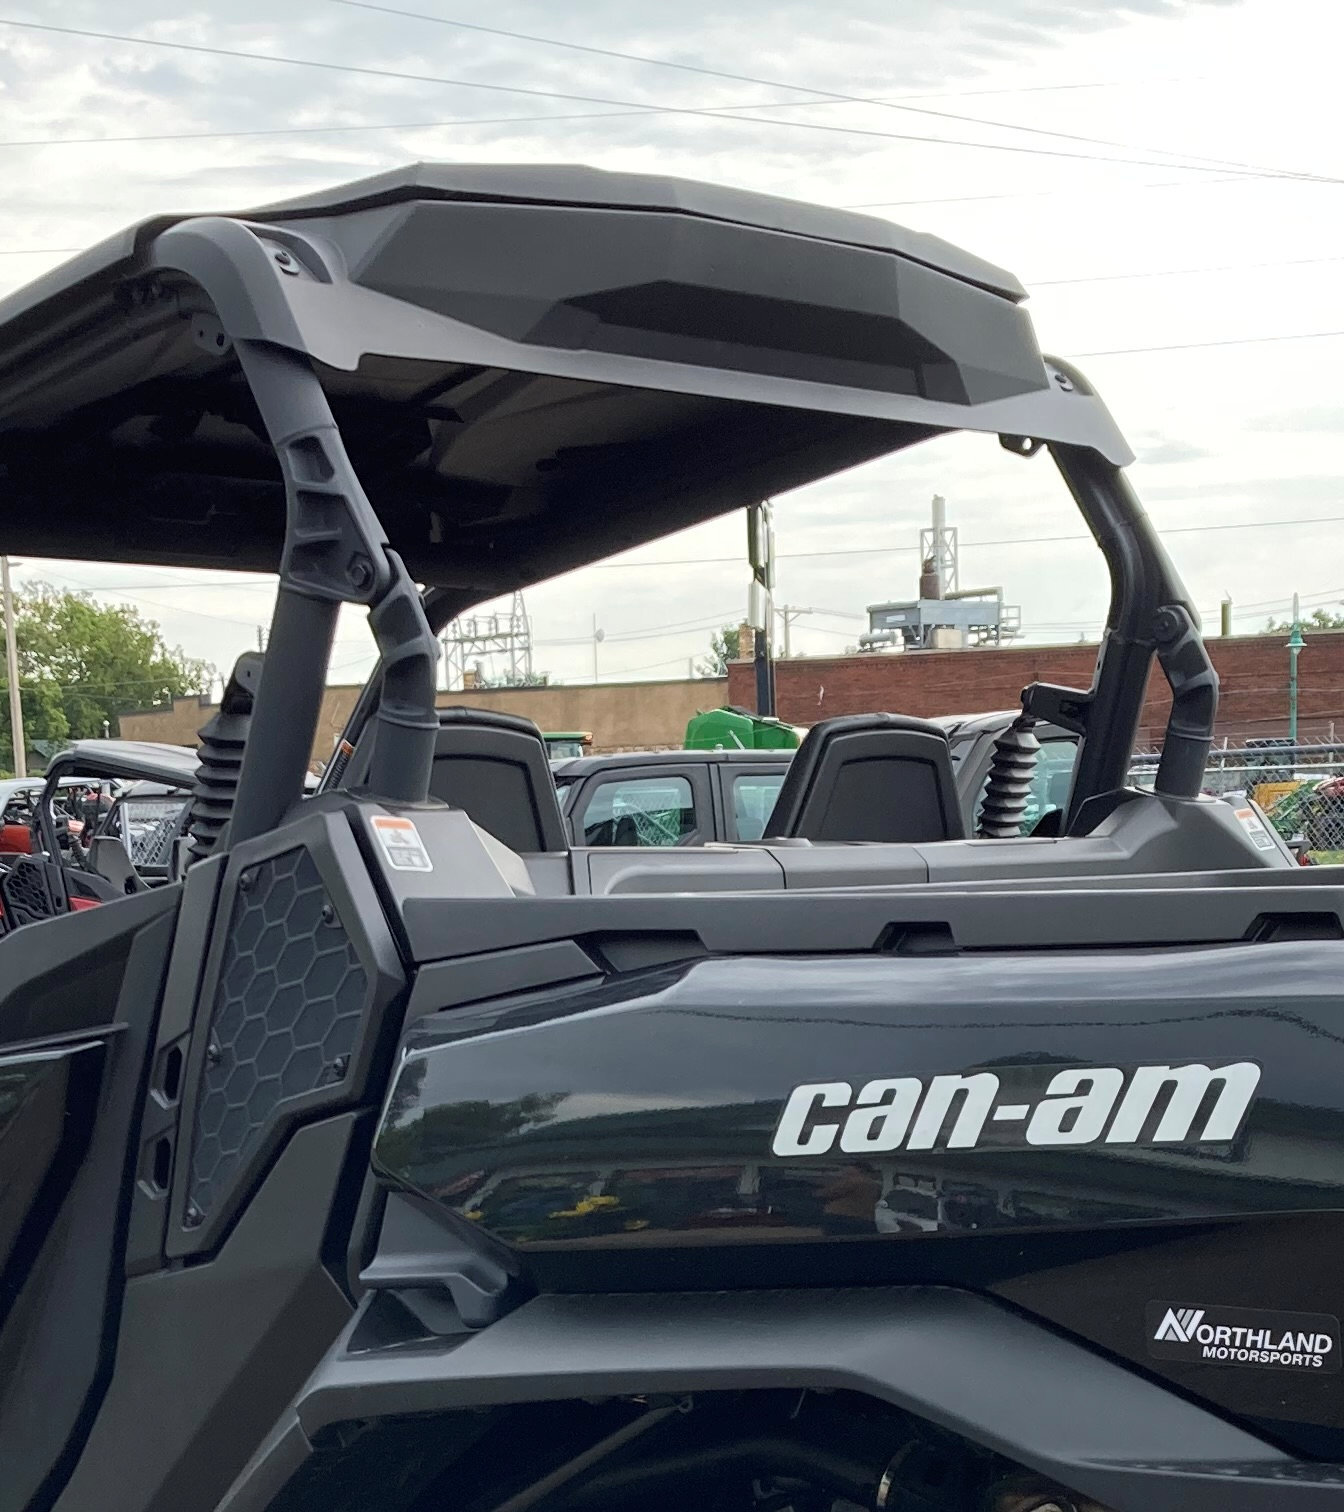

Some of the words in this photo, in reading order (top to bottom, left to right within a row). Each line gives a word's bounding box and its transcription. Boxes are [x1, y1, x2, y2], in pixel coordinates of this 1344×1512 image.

[772, 1061, 1262, 1158] can-am
[1153, 1307, 1333, 1354] NORTHLAND
[1202, 1346, 1324, 1368] MOTORSPORTS
